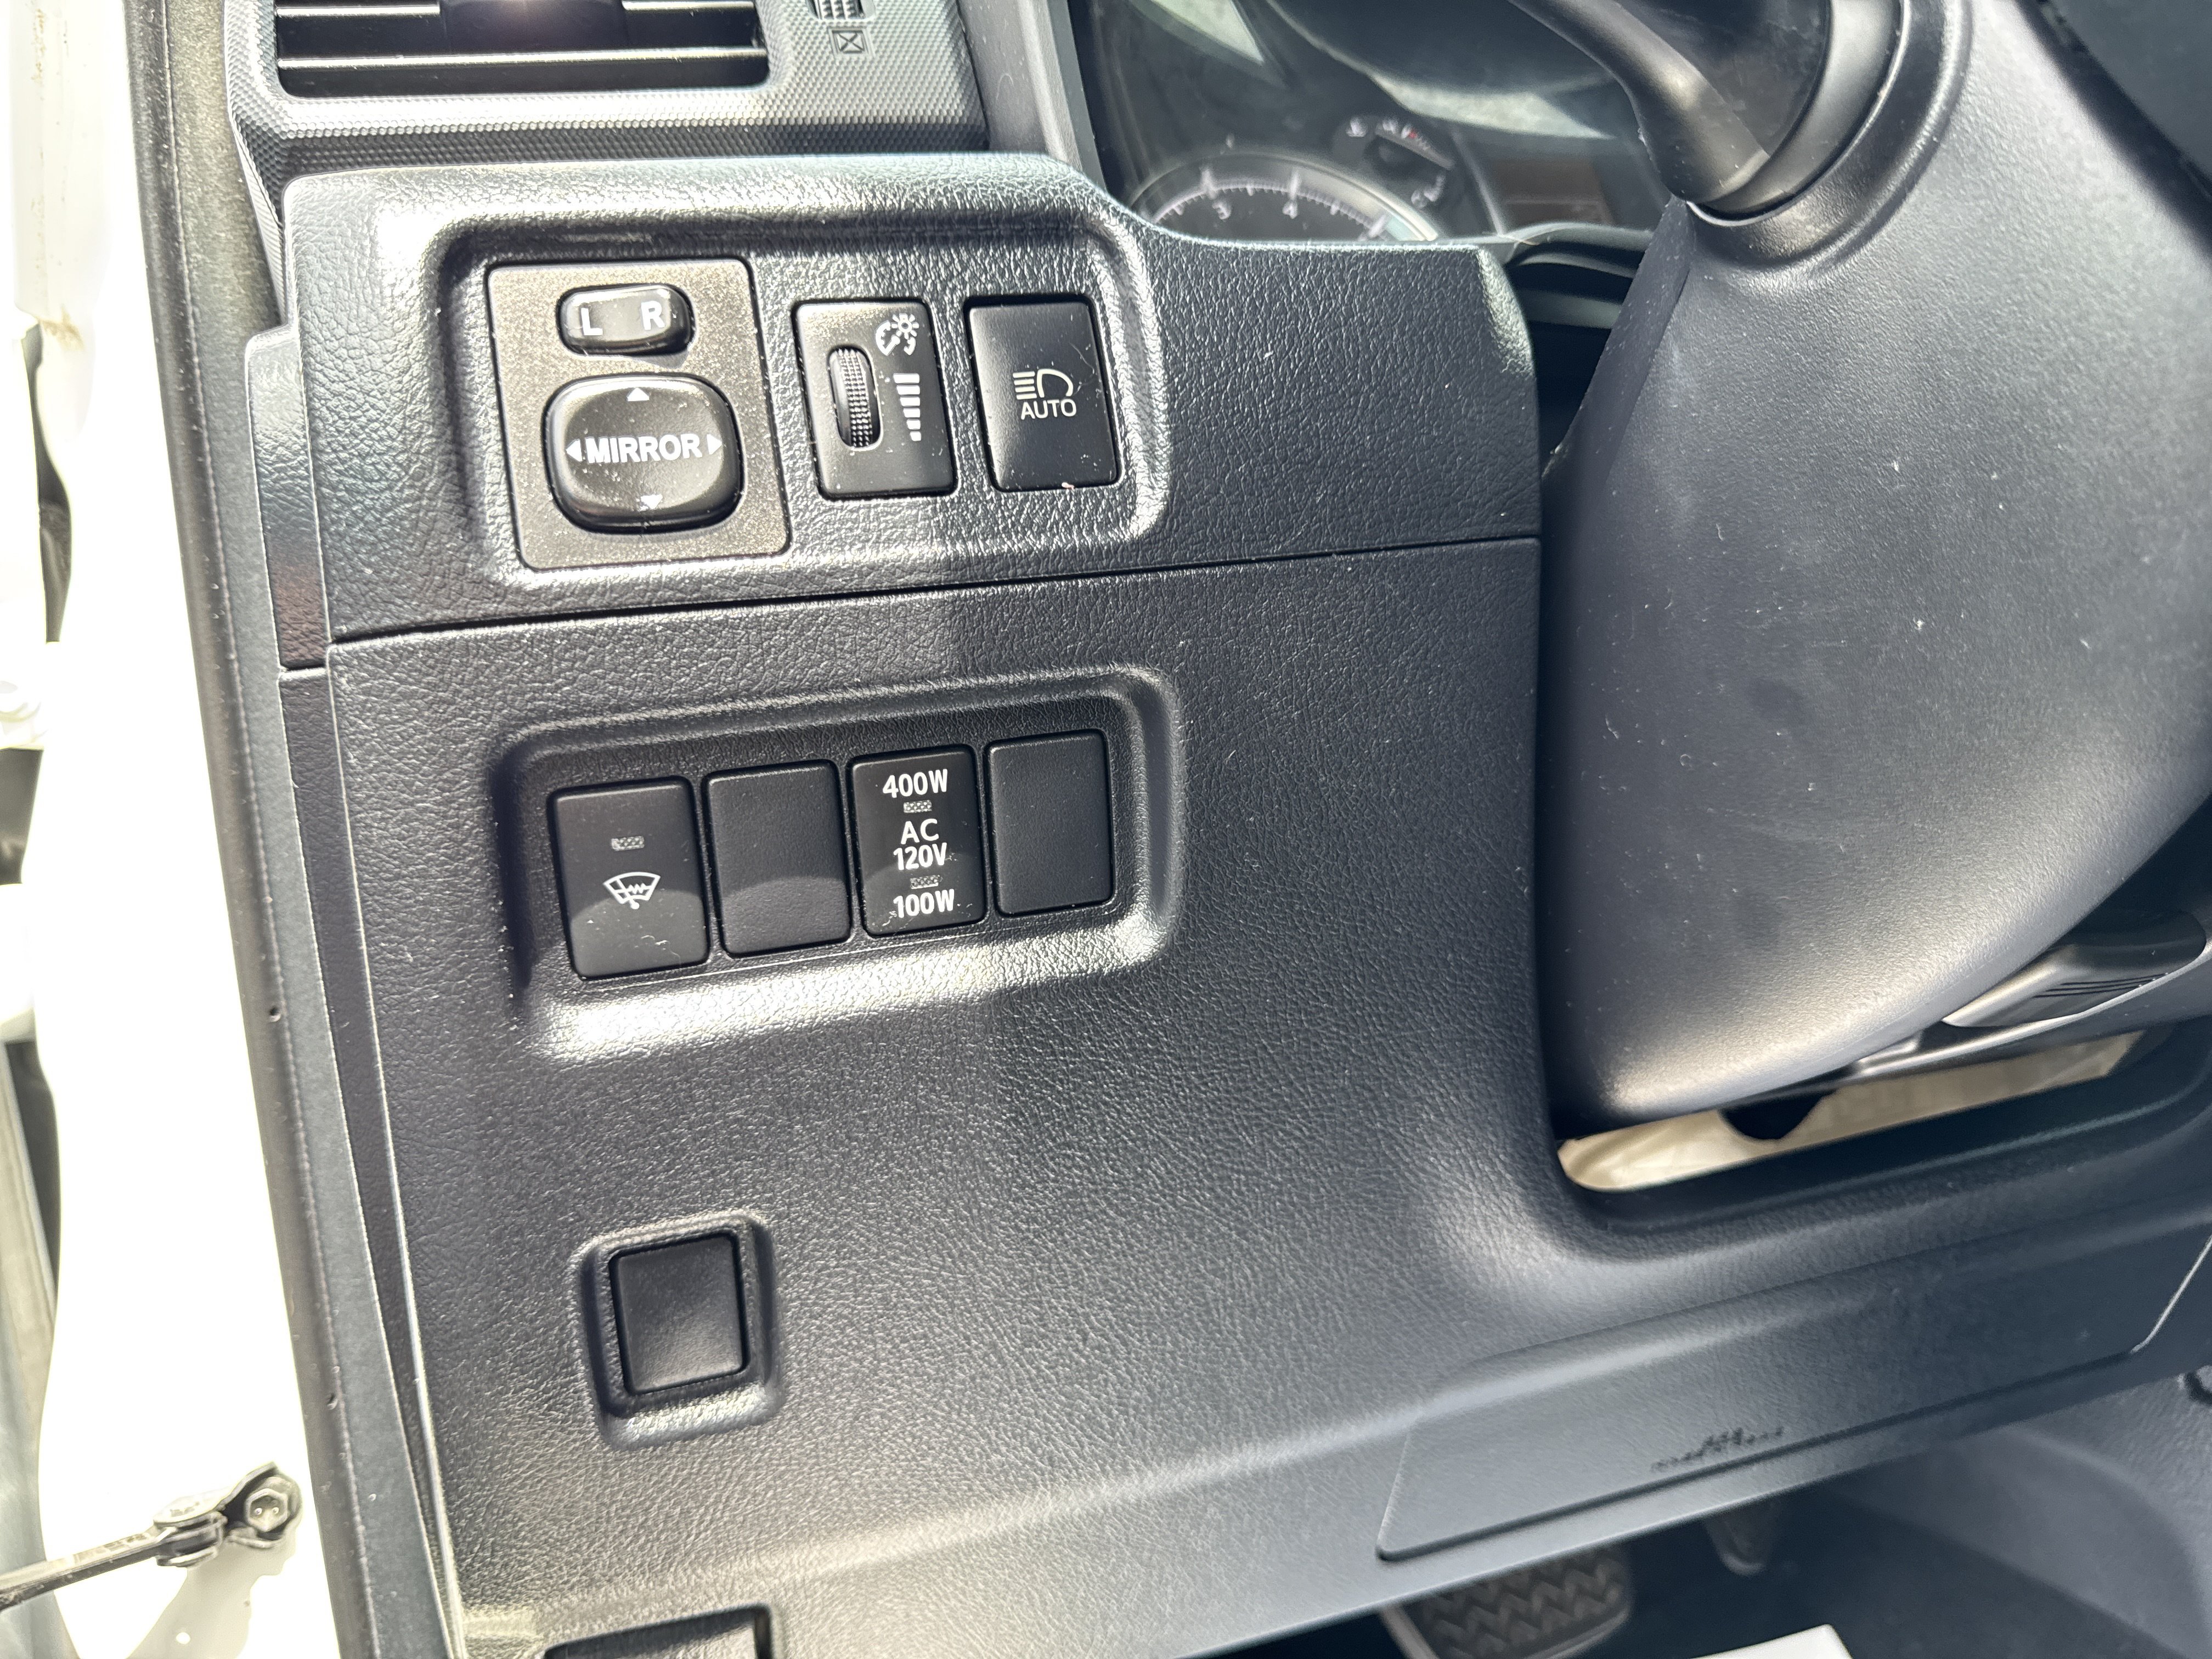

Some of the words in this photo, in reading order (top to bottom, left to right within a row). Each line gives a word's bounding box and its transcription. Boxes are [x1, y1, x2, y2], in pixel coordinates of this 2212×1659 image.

[580, 307, 603, 336] L
[640, 300, 665, 330] R
[1020, 399, 1076, 420] AUTO
[586, 433, 702, 464] MIRROR
[882, 769, 948, 798] 400W
[900, 819, 939, 844] AC
[893, 842, 947, 870] 120V
[893, 889, 955, 918] 100W
